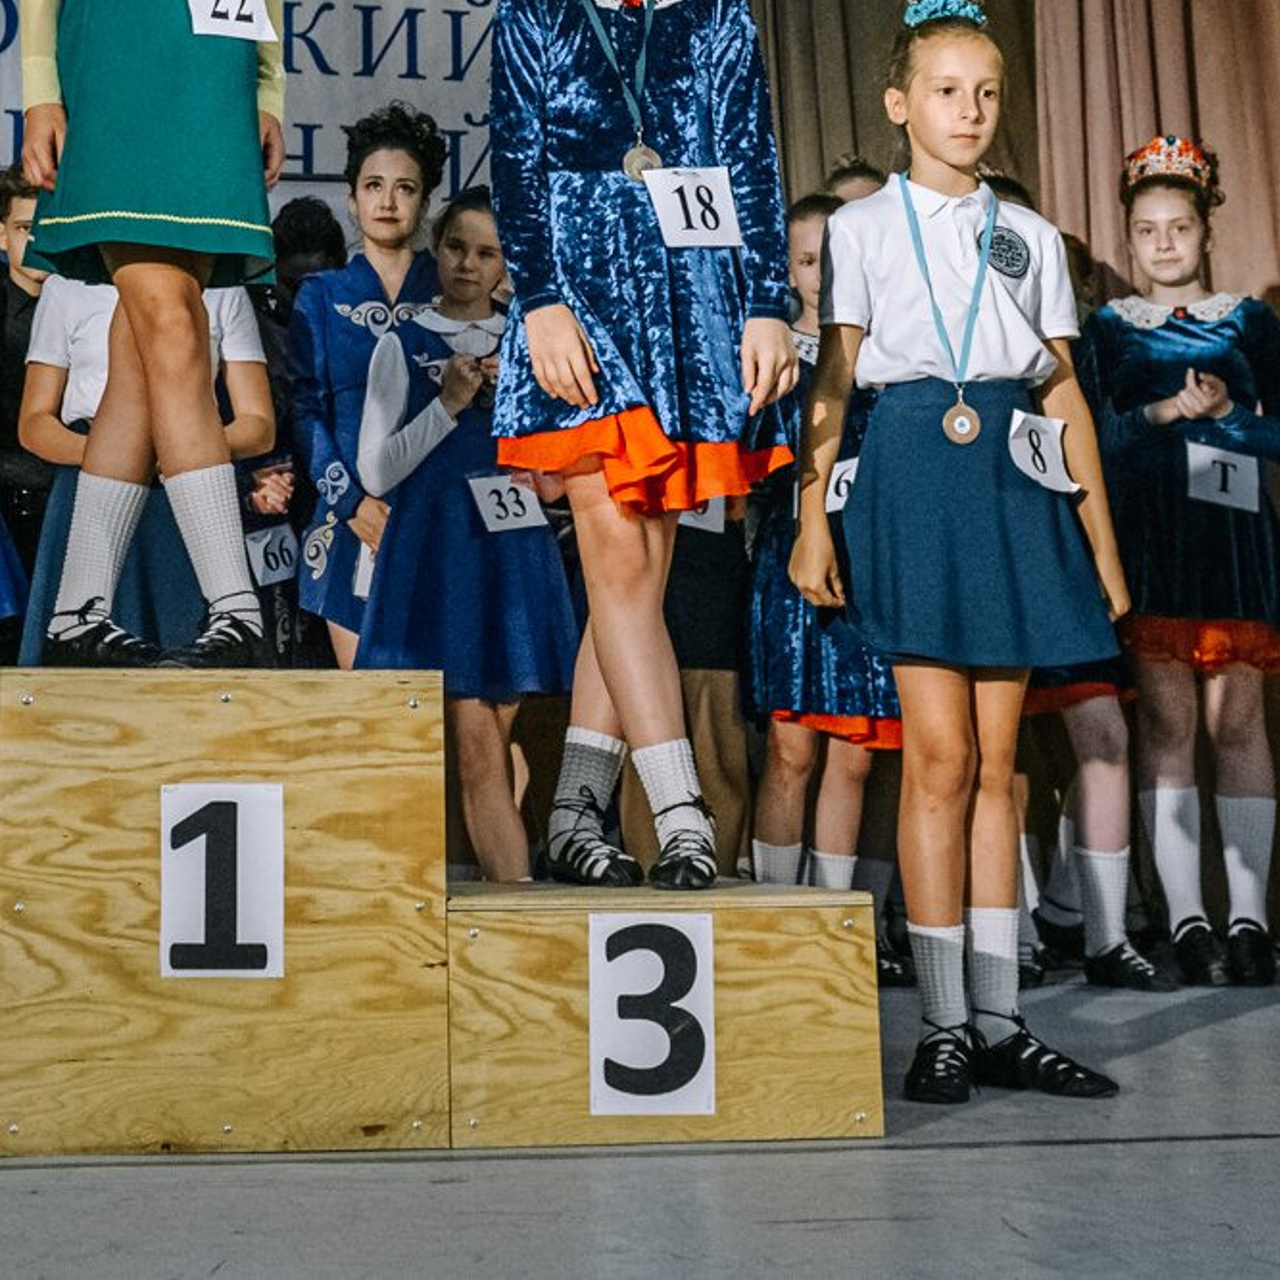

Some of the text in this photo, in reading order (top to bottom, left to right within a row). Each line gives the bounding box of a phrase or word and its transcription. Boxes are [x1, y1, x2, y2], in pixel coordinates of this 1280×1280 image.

[672, 185, 720, 230] 18
[1028, 428, 1047, 474] 8
[488, 486, 526, 520] 33
[263, 535, 293, 572] 66
[169, 801, 268, 970] 1
[603, 923, 706, 1096] 3
